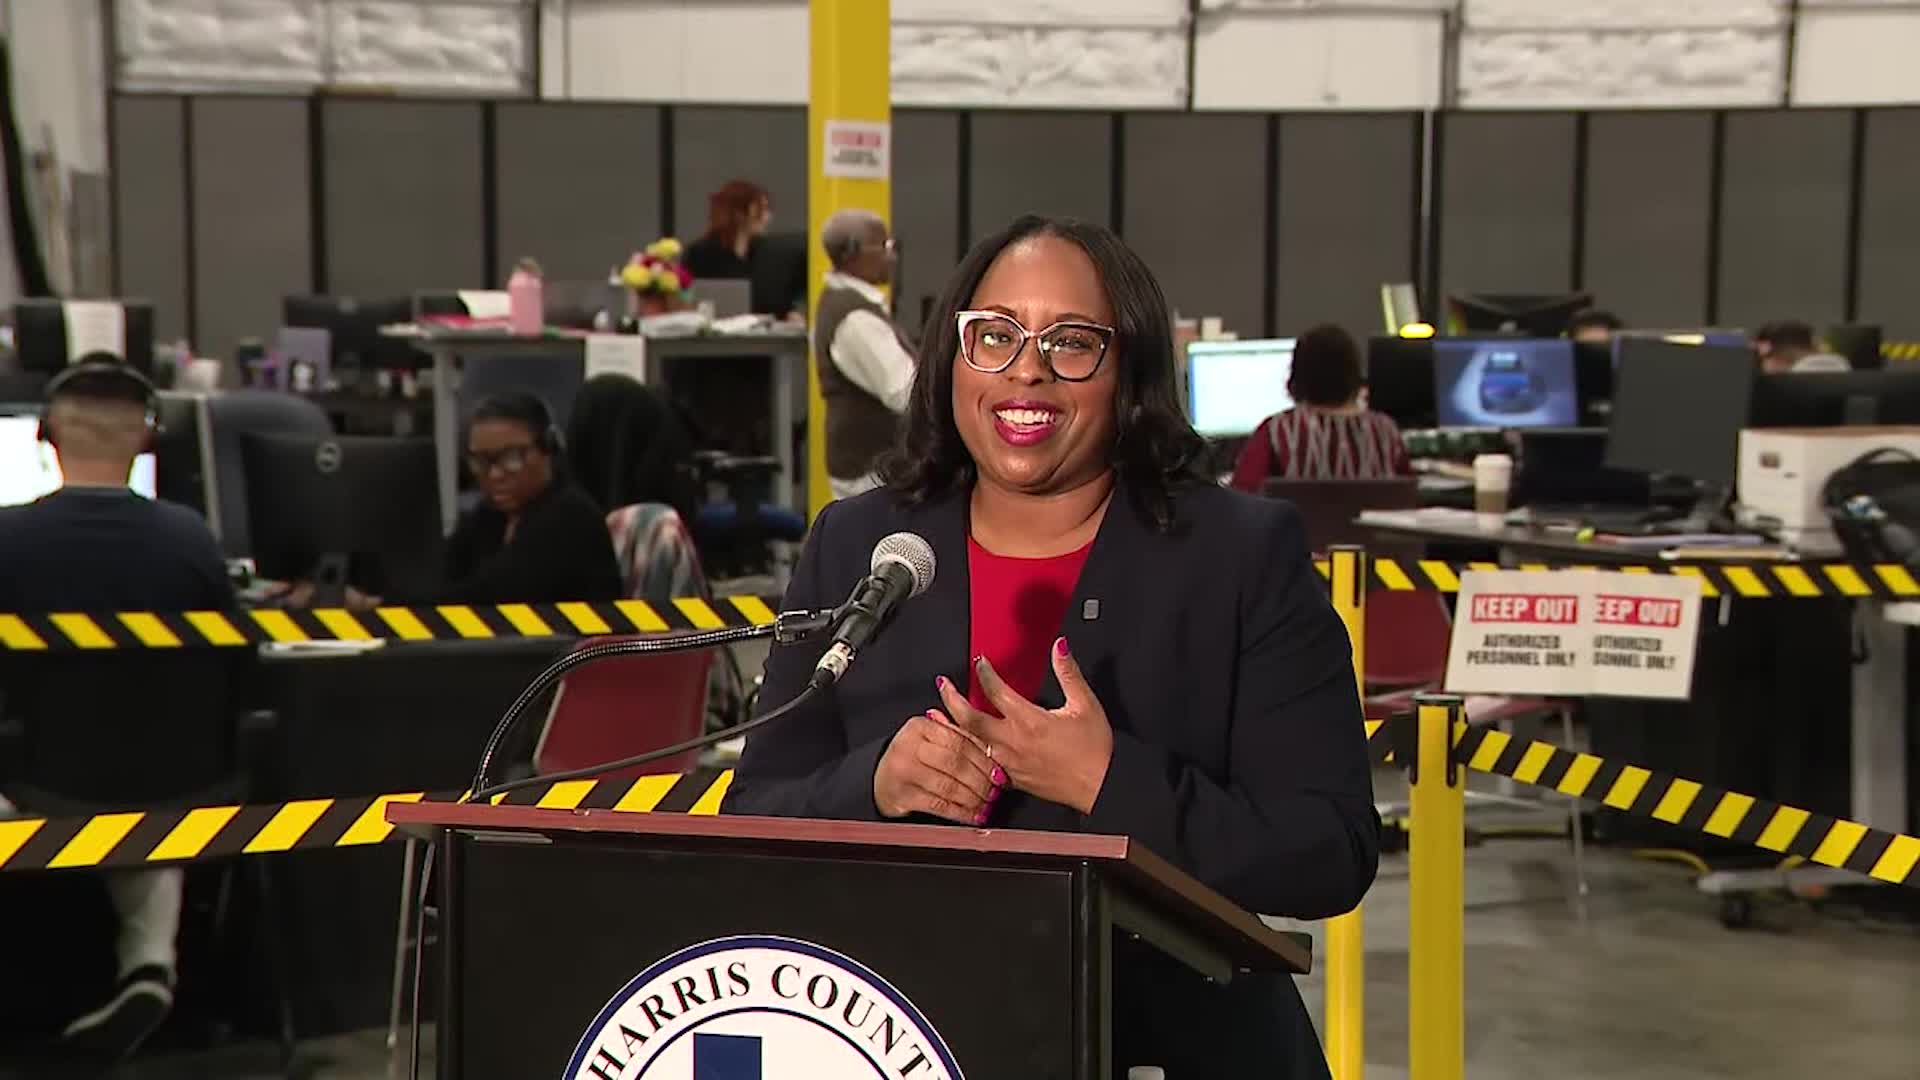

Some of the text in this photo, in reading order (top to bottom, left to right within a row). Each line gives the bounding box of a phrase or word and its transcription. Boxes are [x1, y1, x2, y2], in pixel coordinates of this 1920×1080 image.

[1474, 597, 1575, 622] KEEP OUT
[1638, 600, 1679, 625] OUT
[1482, 634, 1560, 649] AUTHORIZED
[1466, 651, 1575, 667] PERSONNEL ONLY
[586, 961, 942, 1080] HARRIS COUNT
